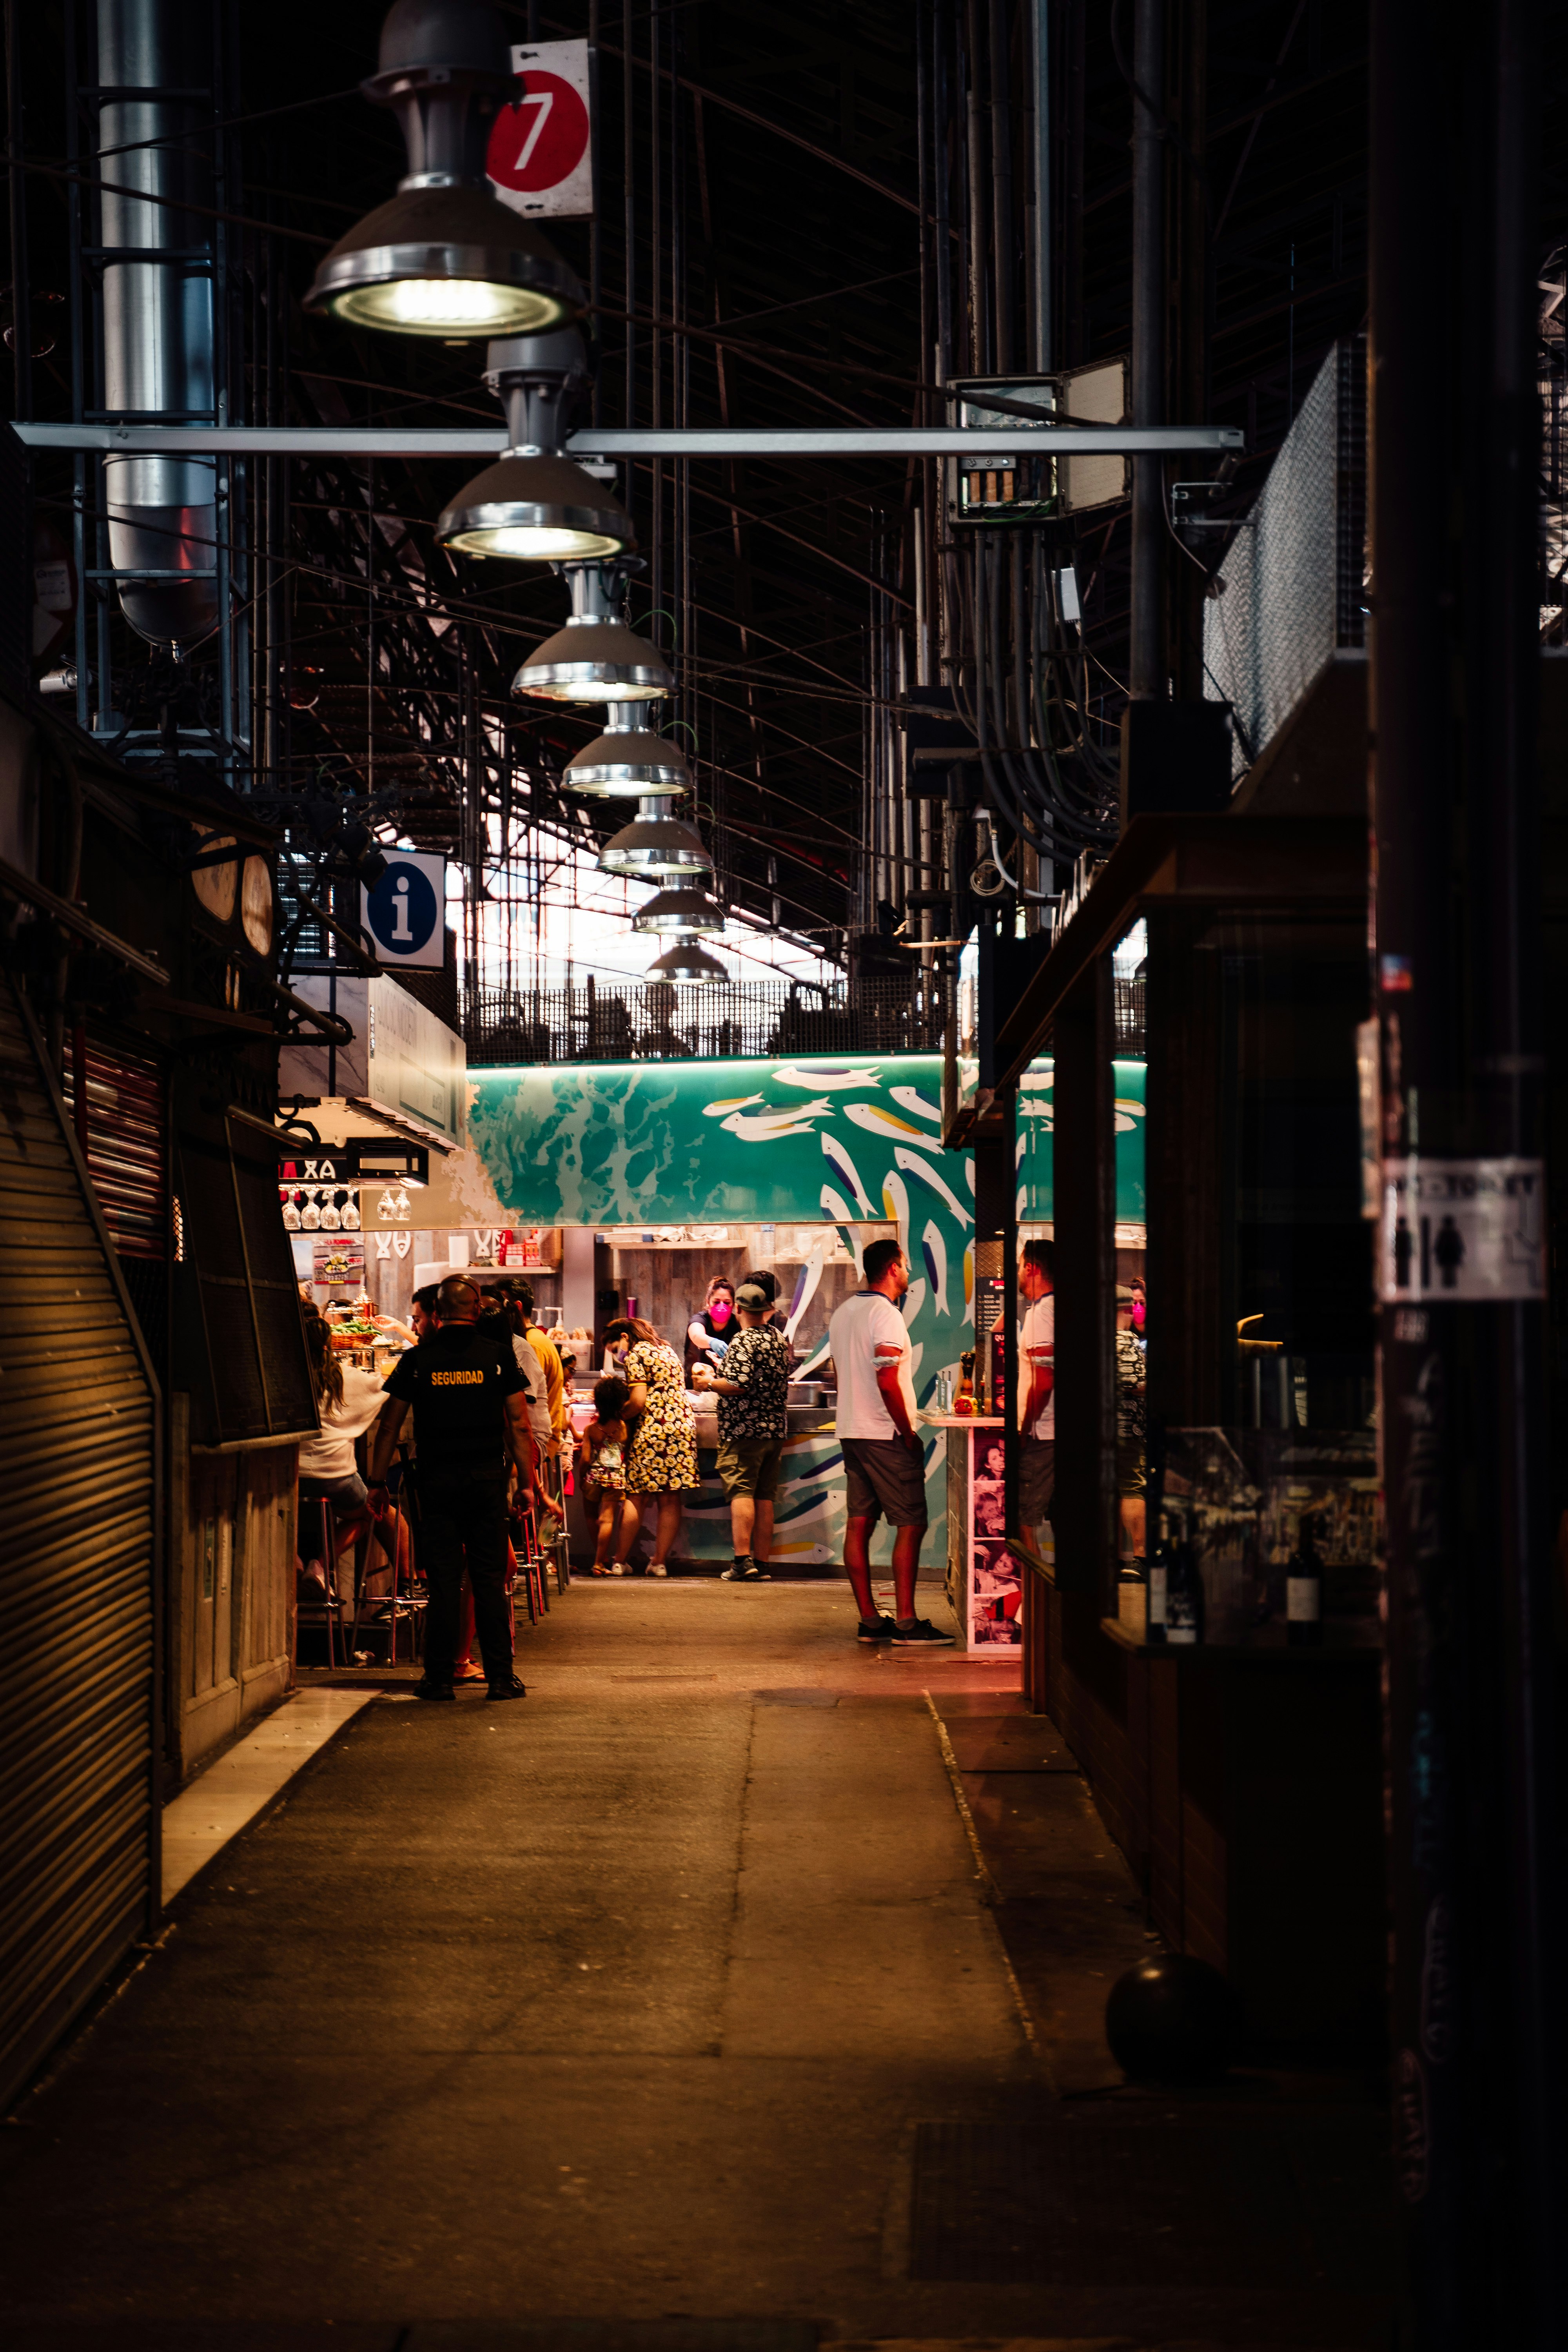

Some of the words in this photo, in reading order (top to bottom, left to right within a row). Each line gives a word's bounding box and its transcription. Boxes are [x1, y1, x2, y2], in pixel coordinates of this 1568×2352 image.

[508, 91, 554, 171] 7
[391, 876, 413, 941] i
[431, 1370, 484, 1386] SEGURIDAD
